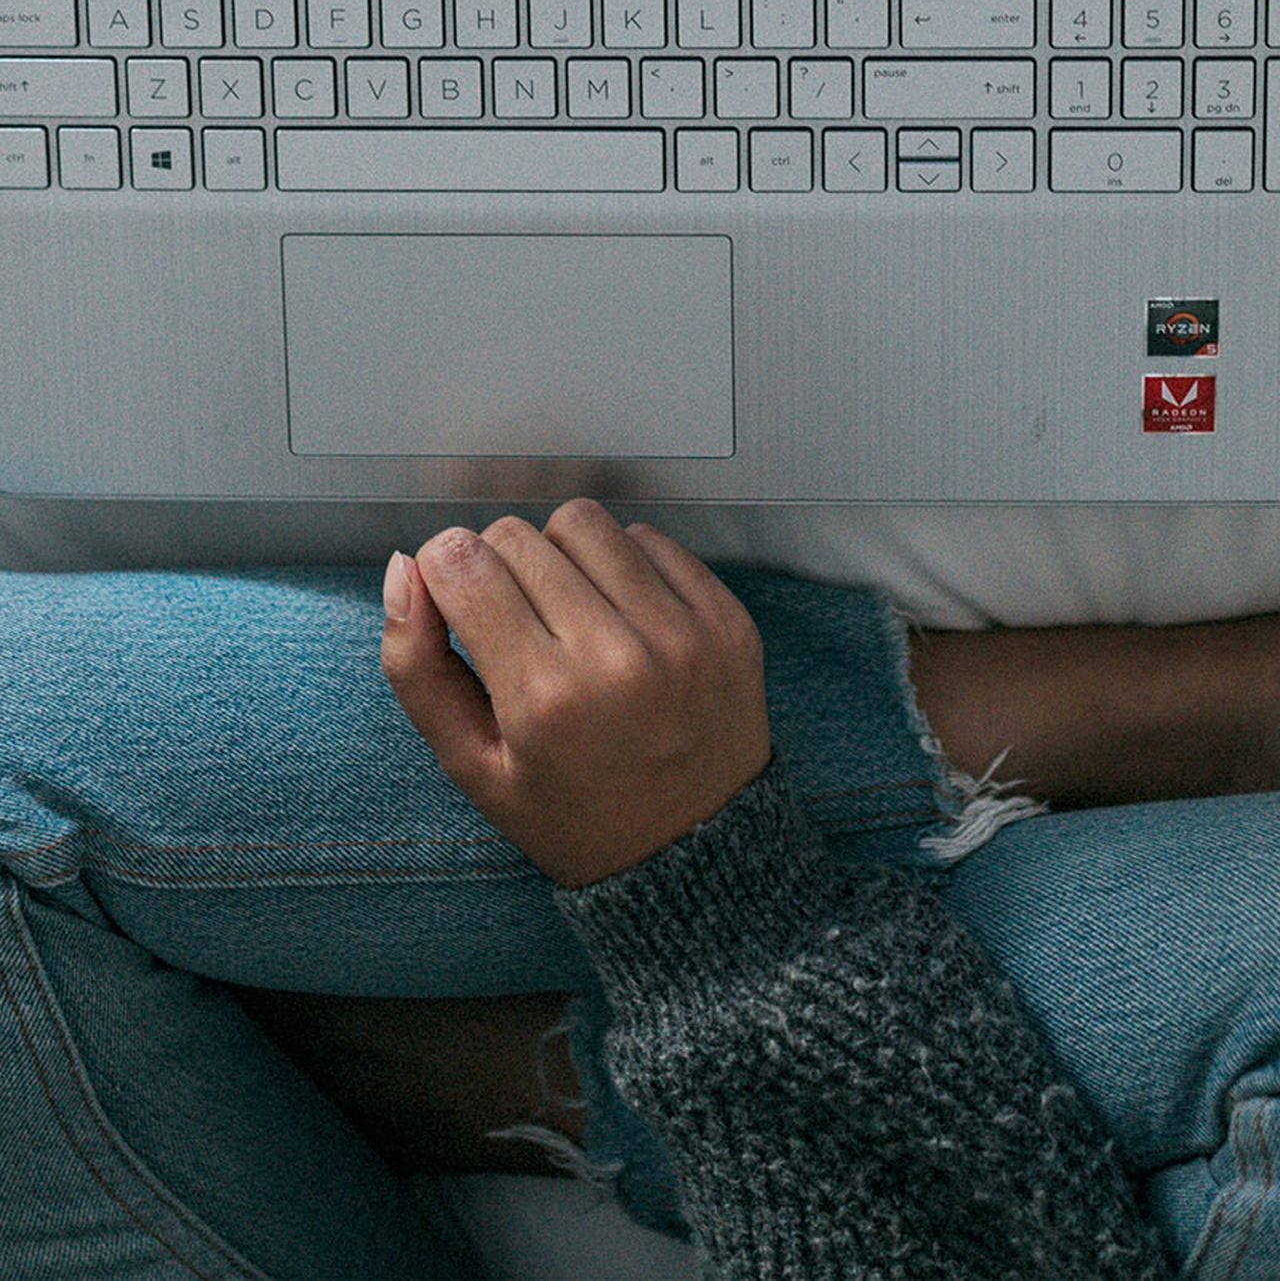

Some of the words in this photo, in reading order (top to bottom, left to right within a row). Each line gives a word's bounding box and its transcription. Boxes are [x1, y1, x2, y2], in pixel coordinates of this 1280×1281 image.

[109, 9, 130, 30] A
[183, 8, 200, 31] S
[254, 8, 275, 31] D
[329, 8, 346, 29] F
[401, 8, 423, 31] G
[476, 9, 496, 30] H
[553, 8, 568, 31] J
[624, 9, 642, 30] K
[700, 9, 715, 31] L
[991, 14, 1020, 24] enter
[873, 69, 908, 79] pause
[150, 78, 167, 100] Z
[222, 79, 240, 100] X
[293, 78, 314, 101] C
[366, 79, 387, 101] V
[441, 78, 461, 101] B
[515, 79, 535, 100] N
[587, 79, 609, 100] M
[996, 84, 1020, 94] shift
[772, 156, 790, 166] ctrl
[1156, 323, 1210, 334] RYZEN
